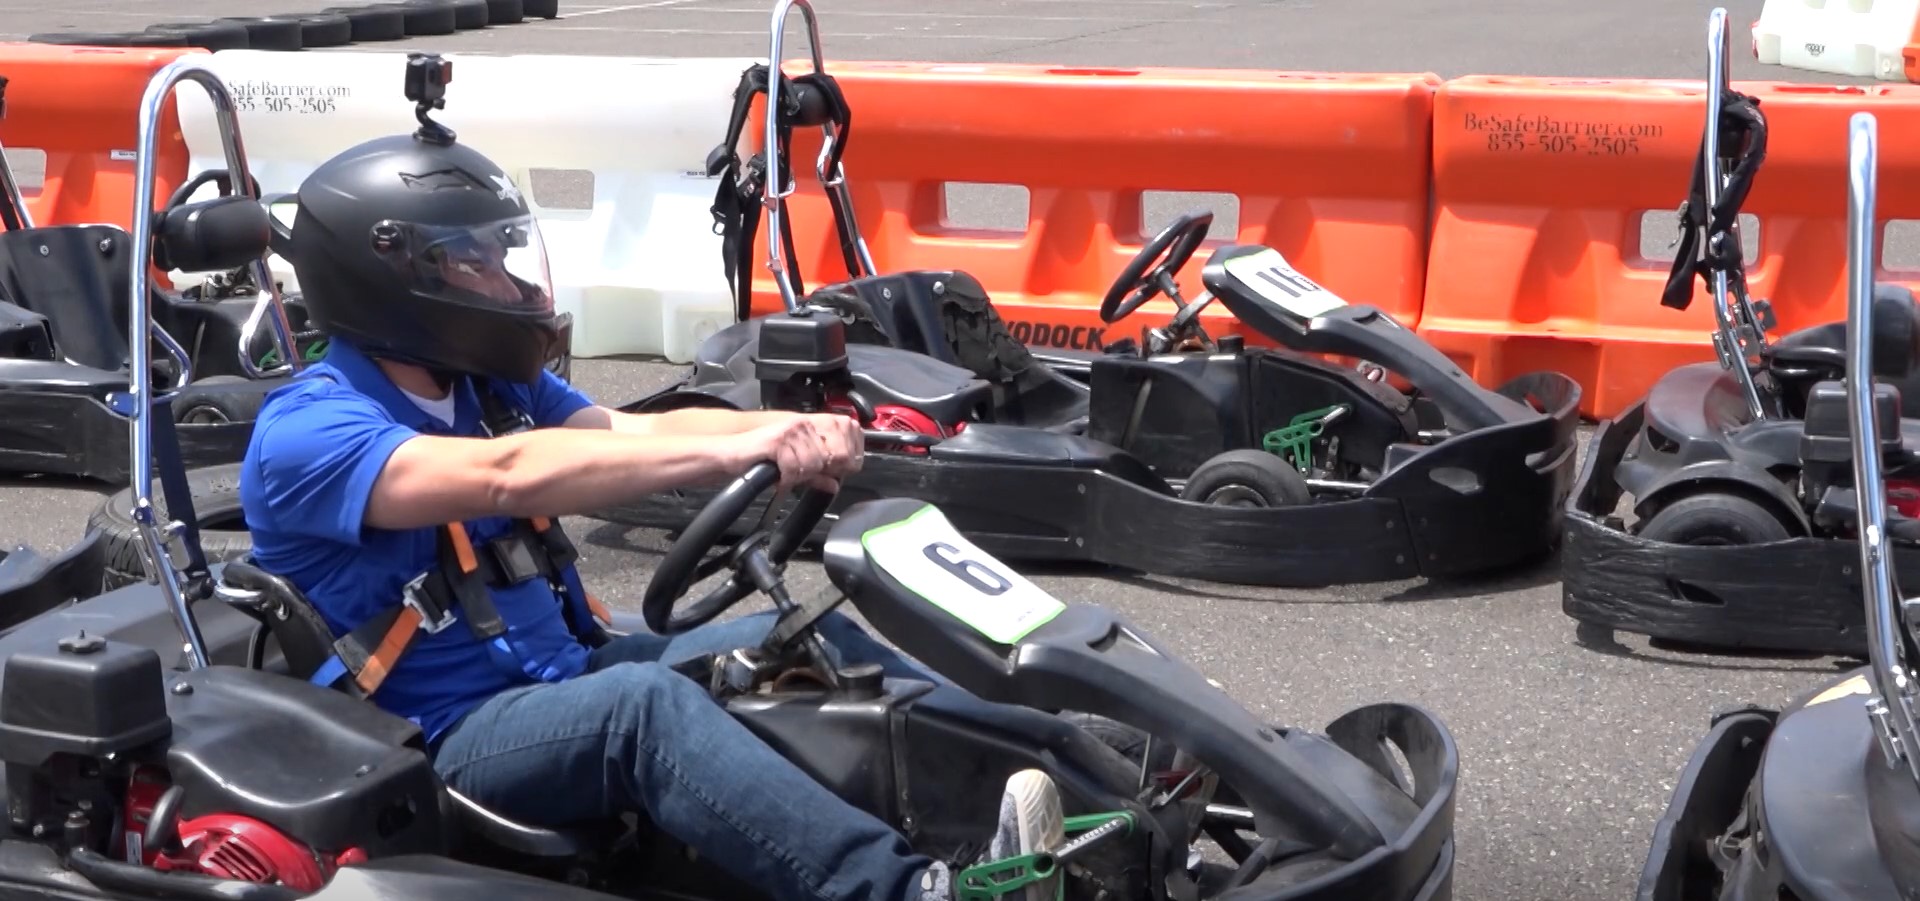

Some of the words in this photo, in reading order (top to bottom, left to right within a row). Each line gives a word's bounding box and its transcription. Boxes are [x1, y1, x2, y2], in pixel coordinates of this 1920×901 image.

[229, 79, 351, 97] SafeBarrier.com
[1464, 112, 1664, 139] BeSafeBarrier.com
[1487, 132, 1640, 156] 855-505-2505
[922, 541, 1014, 597] 6
